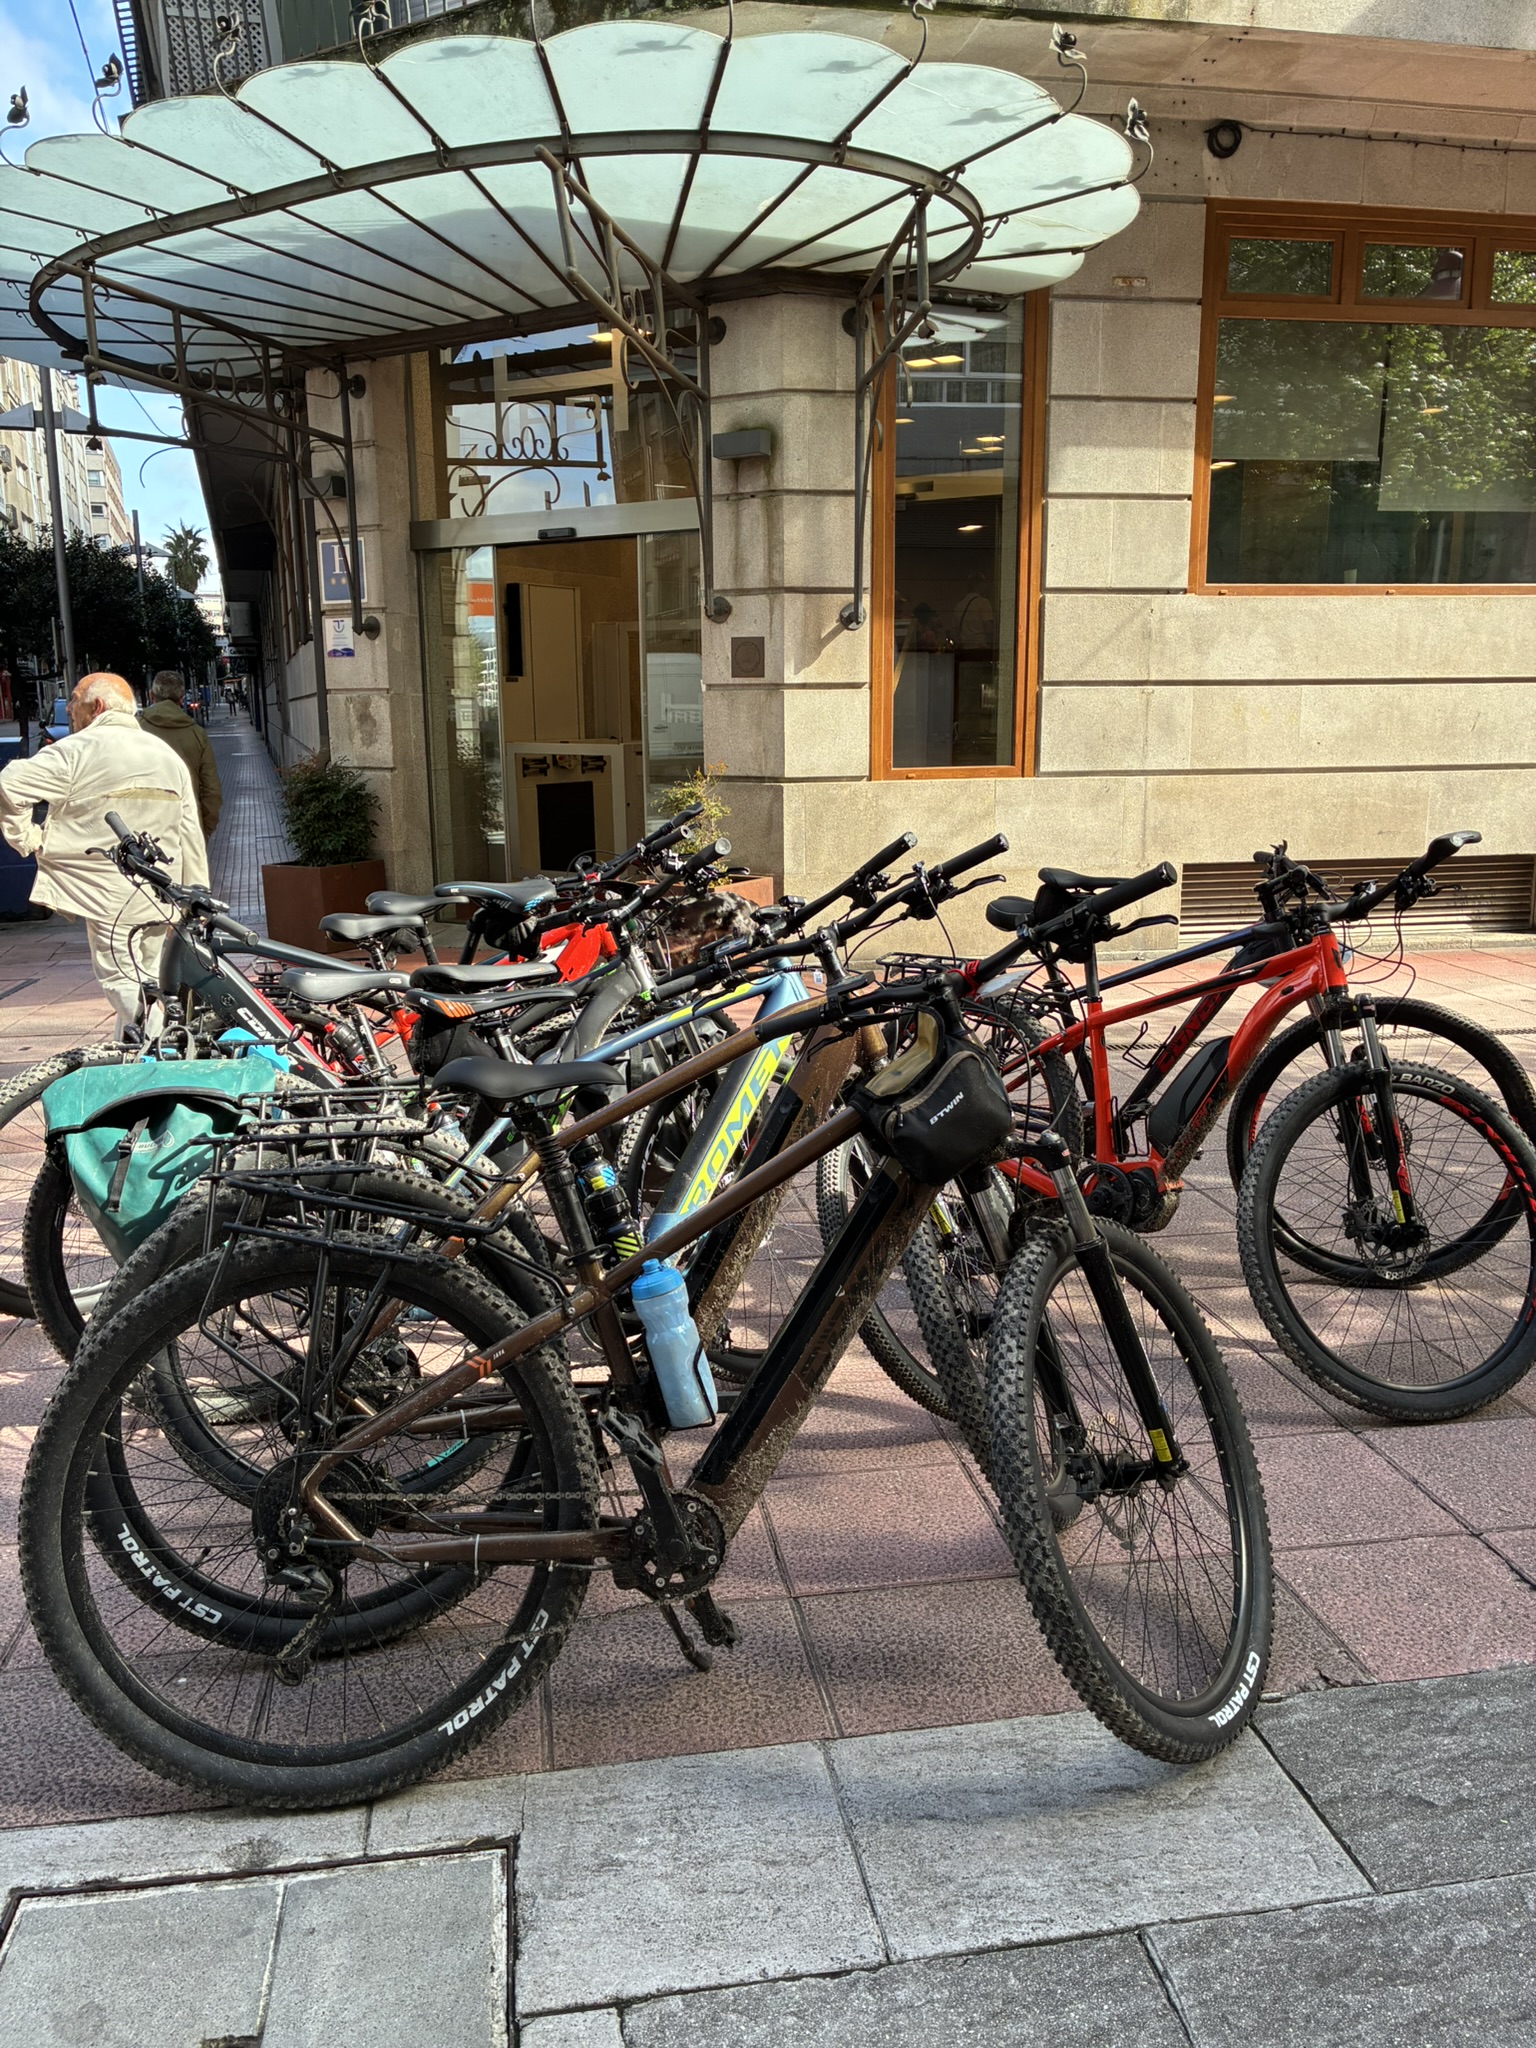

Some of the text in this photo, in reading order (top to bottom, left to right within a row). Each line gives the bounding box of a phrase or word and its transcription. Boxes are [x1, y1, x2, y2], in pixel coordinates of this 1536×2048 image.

[929, 1091, 965, 1125] BTWIN
[1399, 1073, 1455, 1095] BARZO
[117, 1522, 223, 1625] CST PATROL
[437, 1655, 522, 1736] PATROL
[1207, 1651, 1260, 1728] CST PATROL
